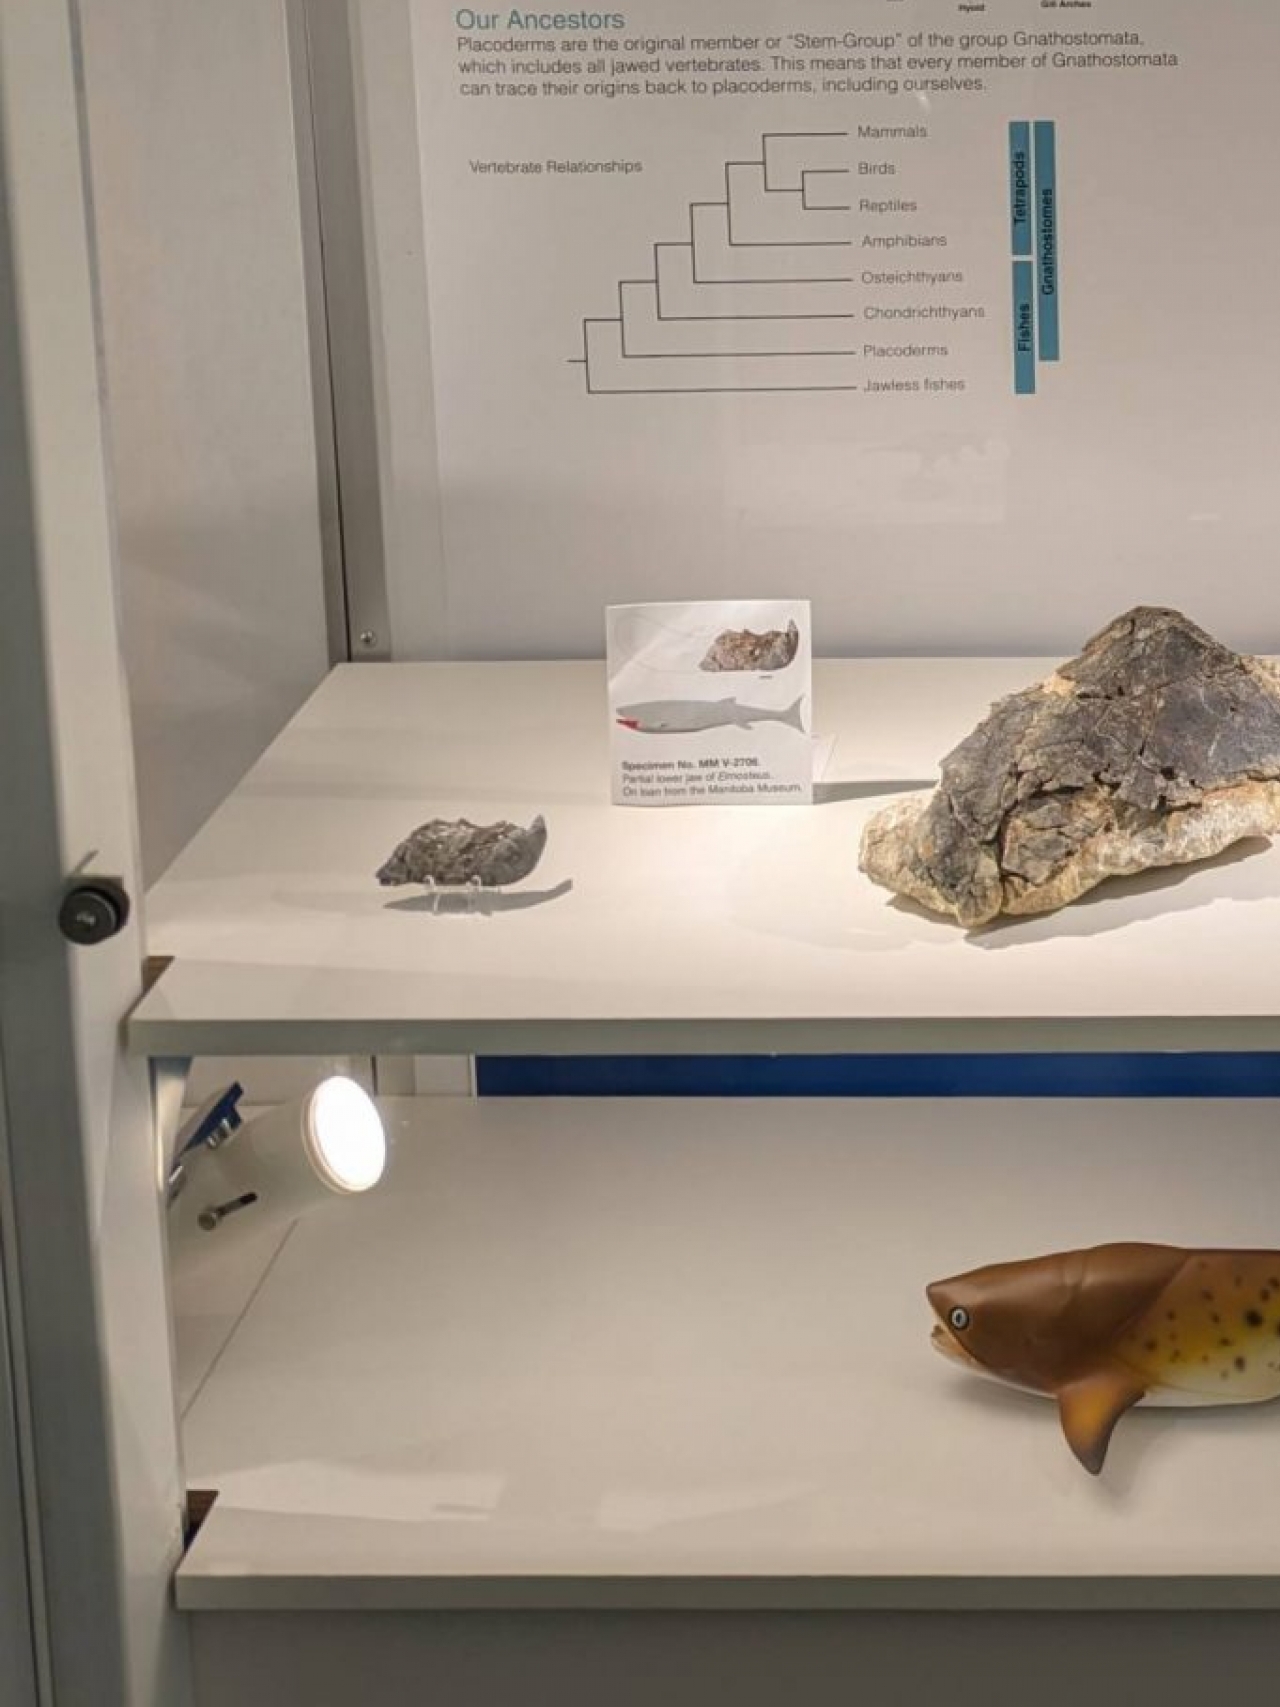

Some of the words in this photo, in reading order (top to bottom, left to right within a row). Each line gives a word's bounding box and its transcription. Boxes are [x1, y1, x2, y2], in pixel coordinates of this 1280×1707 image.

[456, 9, 499, 30] Our
[506, 9, 626, 30] Ancestors
[457, 36, 556, 52] Placoderms
[561, 39, 588, 52] are
[592, 36, 620, 51] the
[624, 35, 684, 54] original
[690, 35, 760, 50] member
[765, 38, 782, 49] or
[907, 33, 926, 48] of
[928, 33, 954, 47] the
[959, 34, 1008, 50] group
[458, 59, 506, 74] which
[510, 58, 582, 74] includes
[587, 58, 605, 73] all
[610, 58, 660, 76] jawed
[770, 56, 805, 71] This
[810, 58, 866, 70] means
[871, 54, 903, 70] that
[907, 56, 953, 72] every
[957, 53, 1026, 68] member
[1030, 53, 1047, 68] of
[1052, 52, 1178, 68] Gnathostomata
[460, 83, 490, 96] can
[496, 82, 538, 96] trace
[542, 80, 578, 95] their
[584, 80, 641, 97] origins
[645, 79, 685, 94] back
[692, 79, 707, 94] to
[712, 78, 817, 96] placoderms,
[823, 77, 898, 94] including
[903, 76, 986, 91] ourselves.
[858, 124, 927, 138] Mammals
[470, 160, 542, 174] Vertebrate
[547, 159, 642, 175] Relationships
[858, 162, 896, 175] Birds
[1014, 151, 1030, 226] Tetrapods
[860, 200, 918, 214] Reptiles
[862, 235, 947, 250] Amphibians
[1041, 188, 1054, 295] Gnathostomes
[862, 271, 964, 286] Osteichthyans
[864, 305, 986, 321] Chondrichthyans
[1018, 304, 1030, 352] Fishes
[864, 344, 948, 358] Placoderms
[864, 380, 920, 392] Jawless
[924, 378, 965, 392] fishes
